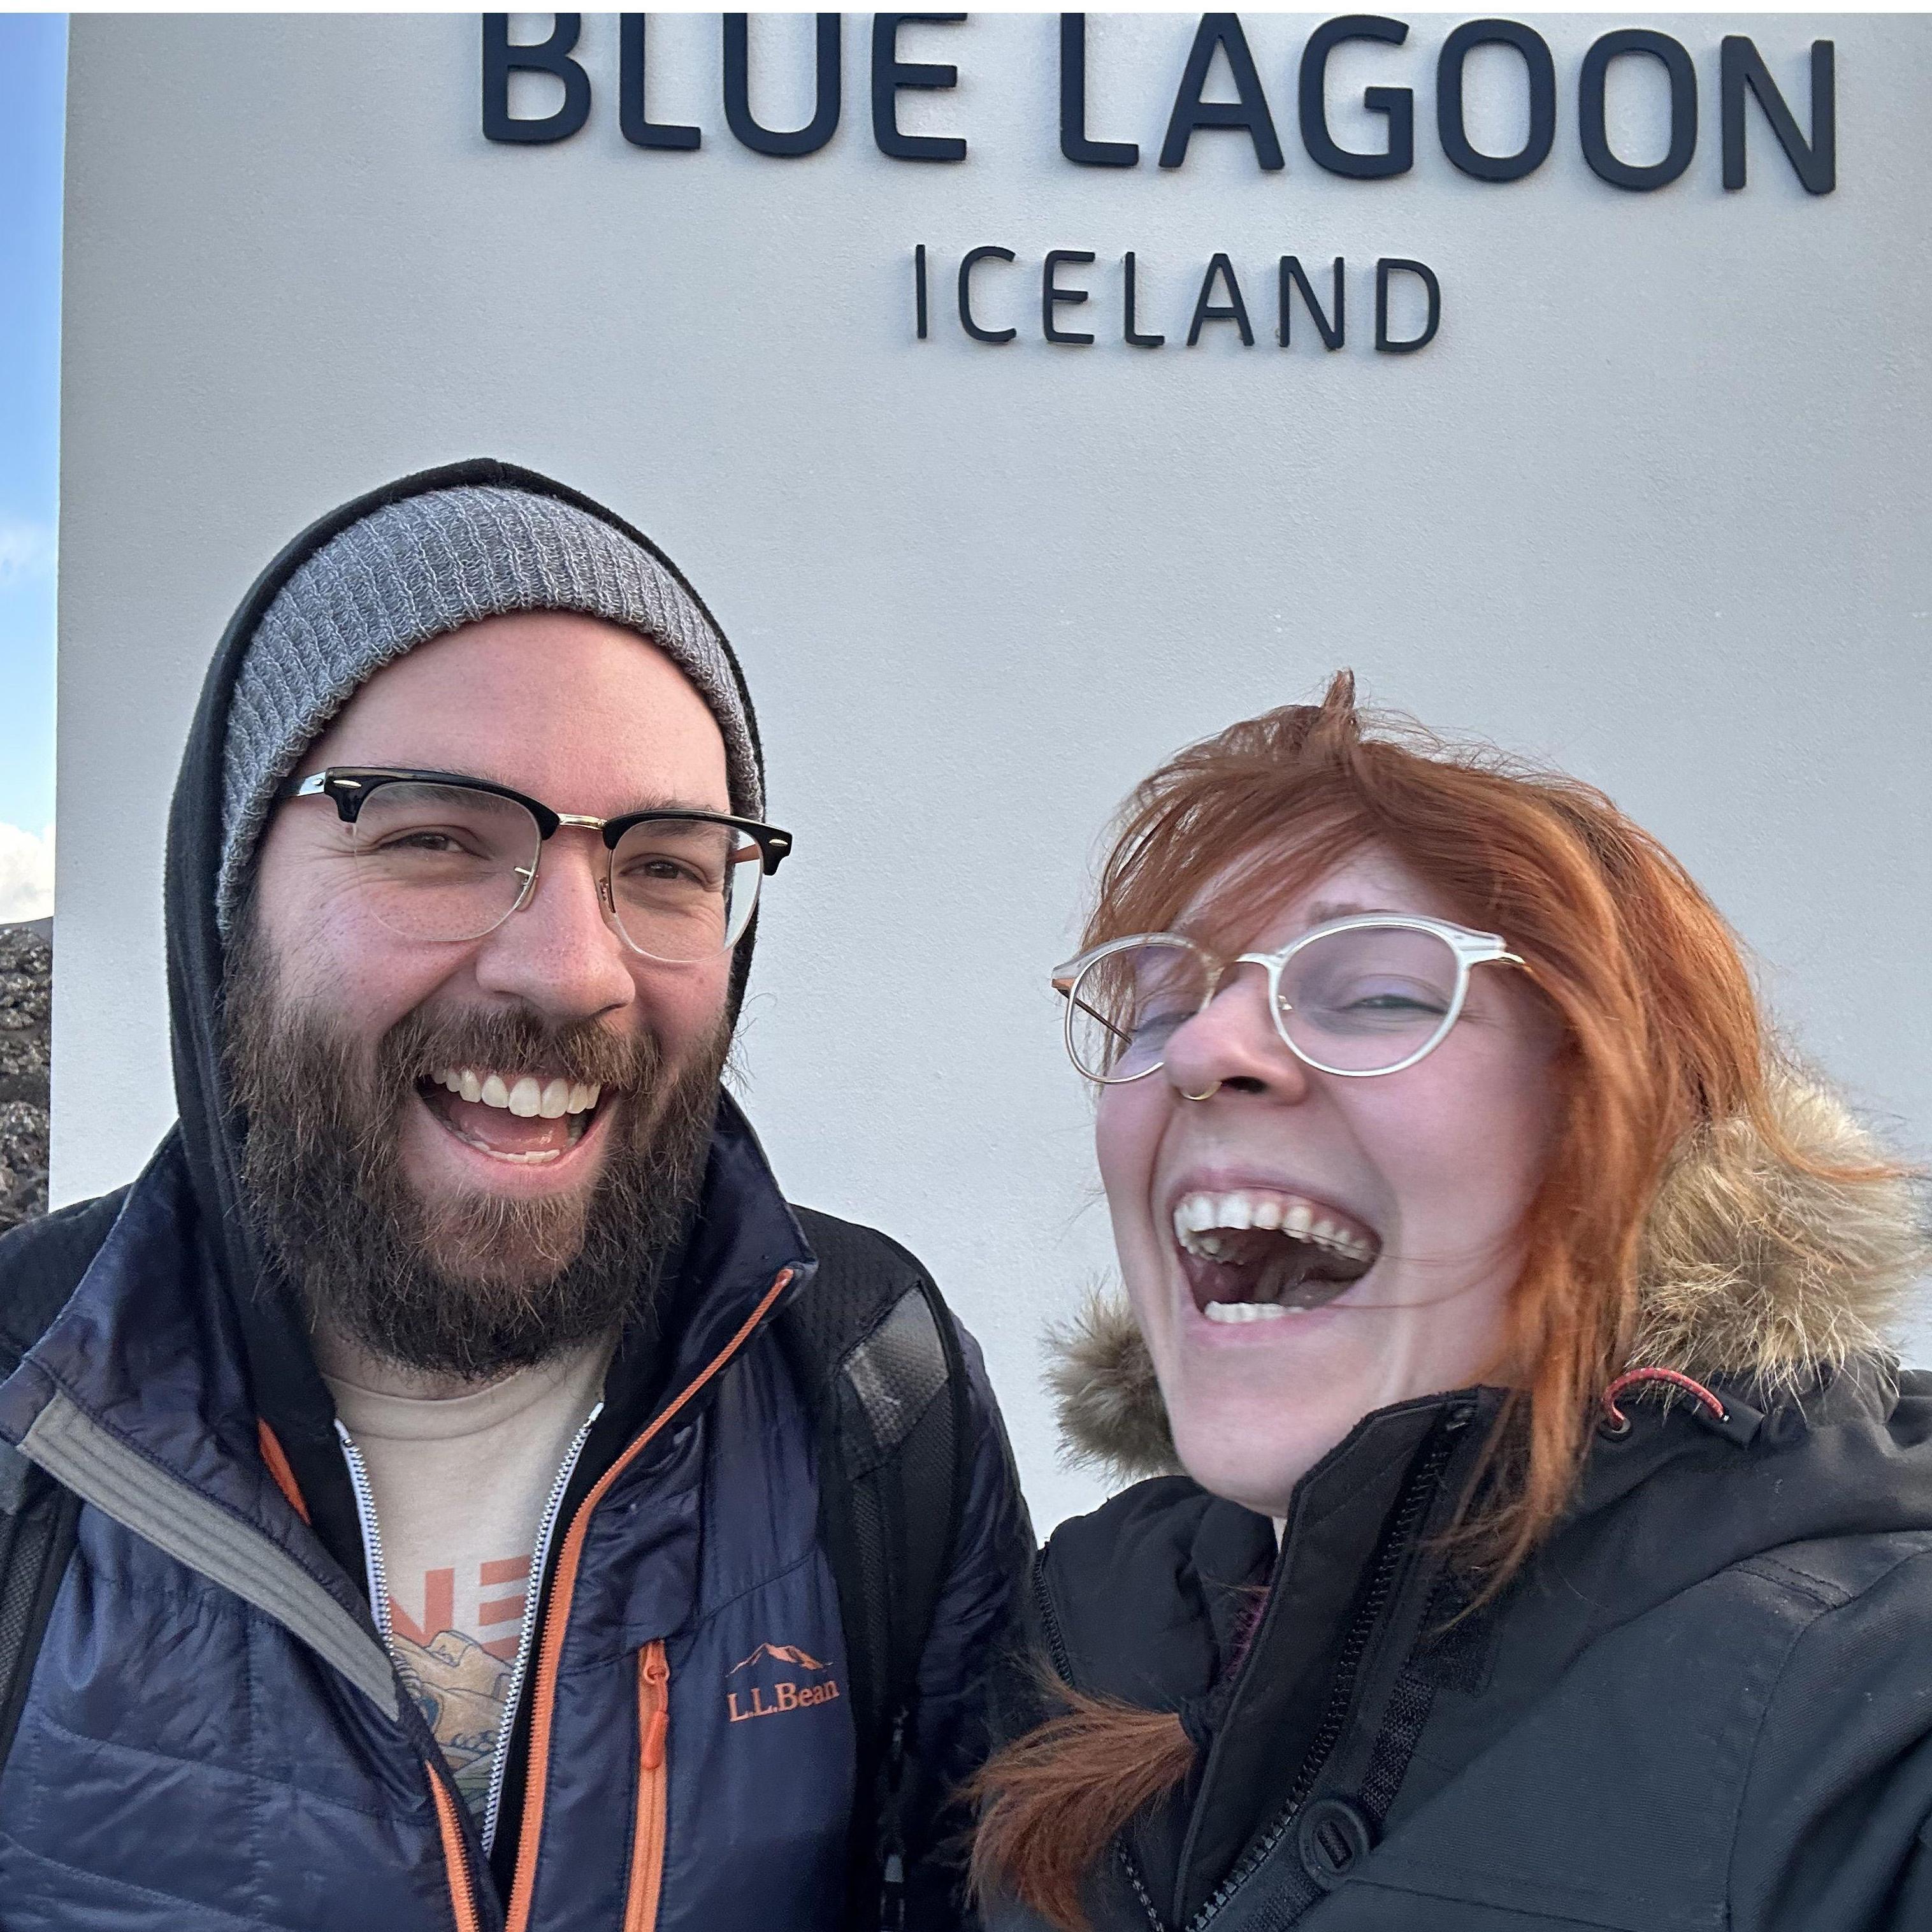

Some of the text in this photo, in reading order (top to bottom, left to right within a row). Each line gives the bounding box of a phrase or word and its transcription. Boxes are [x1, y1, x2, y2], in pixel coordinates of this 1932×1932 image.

[482, 13, 1836, 198] BLUE LAGOON
[915, 244, 1441, 356] ICELAND
[727, 1680, 840, 1722] L.L.Bean
